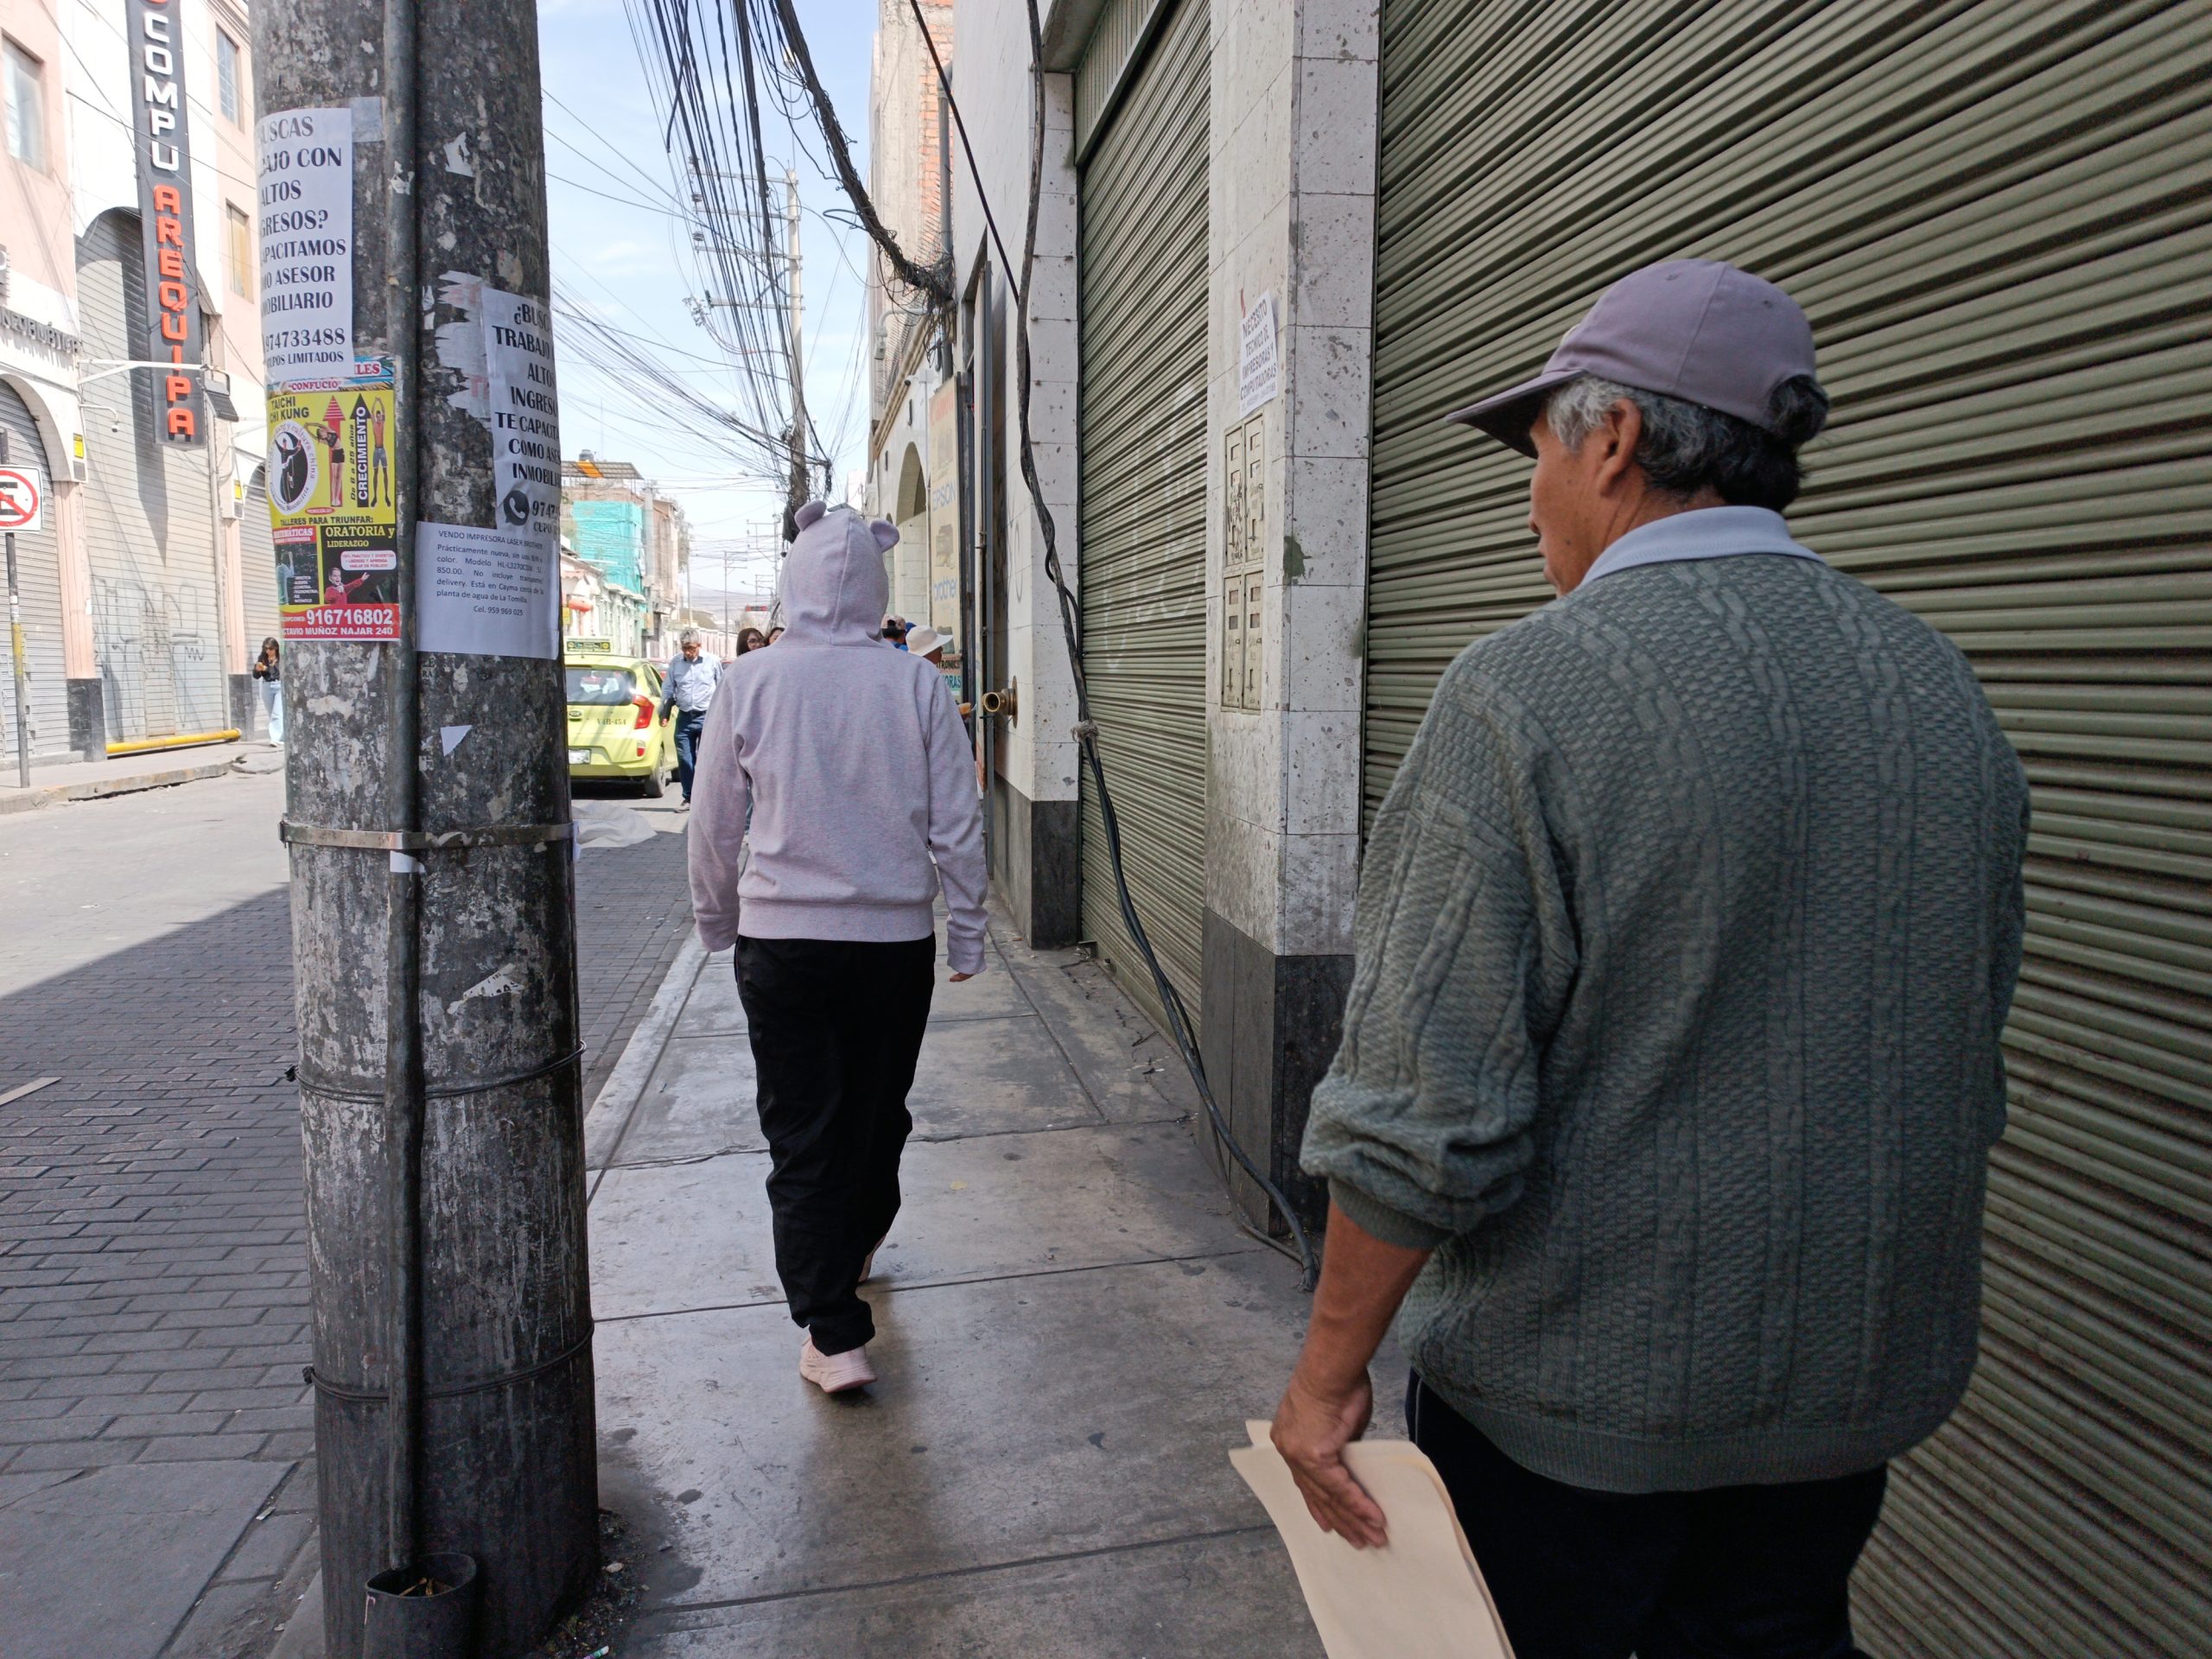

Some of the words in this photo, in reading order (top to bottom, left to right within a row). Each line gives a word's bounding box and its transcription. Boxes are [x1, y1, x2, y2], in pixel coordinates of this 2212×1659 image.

[143, 11, 180, 172] COMPU
[261, 149, 290, 174] AJO
[296, 147, 342, 168] CON
[261, 179, 302, 207] ALTOS
[275, 264, 335, 286] ASESOR
[154, 184, 194, 436] AREQUIPA
[513, 303, 550, 332] ¿BUSC
[1243, 298, 1268, 340] NECESITO
[0, 306, 82, 357] NFORMÁTICA
[265, 327, 346, 353] 974733488
[491, 324, 550, 360] TRABAJO
[288, 351, 344, 365] LIMITADOS
[354, 363, 381, 375] LES
[1240, 362, 1277, 401] COMPUTADORAS
[281, 407, 309, 420] KUNG
[494, 411, 518, 429] TE
[356, 406, 368, 501] CRECIMIENTO
[508, 438, 544, 460] COMO
[546, 446, 562, 466] ASES
[932, 481, 956, 512] EPSON
[325, 525, 385, 537] ORATORIA
[387, 527, 396, 538] y
[438, 530, 465, 540] VENDO
[467, 531, 506, 543] IMPRESORA
[506, 537, 524, 546] LASER
[437, 543, 488, 556] Prácticamente
[465, 557, 492, 567] Modelo
[436, 566, 464, 575] 850.00.
[492, 571, 514, 581] incluye
[436, 578, 467, 589] delivery.
[470, 578, 486, 588] Está
[499, 583, 518, 593] Cayma
[436, 589, 460, 598] planta
[306, 608, 393, 626] 916716802
[473, 605, 486, 613] Cel.
[305, 626, 338, 635] MUÑOZ
[340, 626, 373, 635] NAJAR
[375, 626, 393, 635] 240
